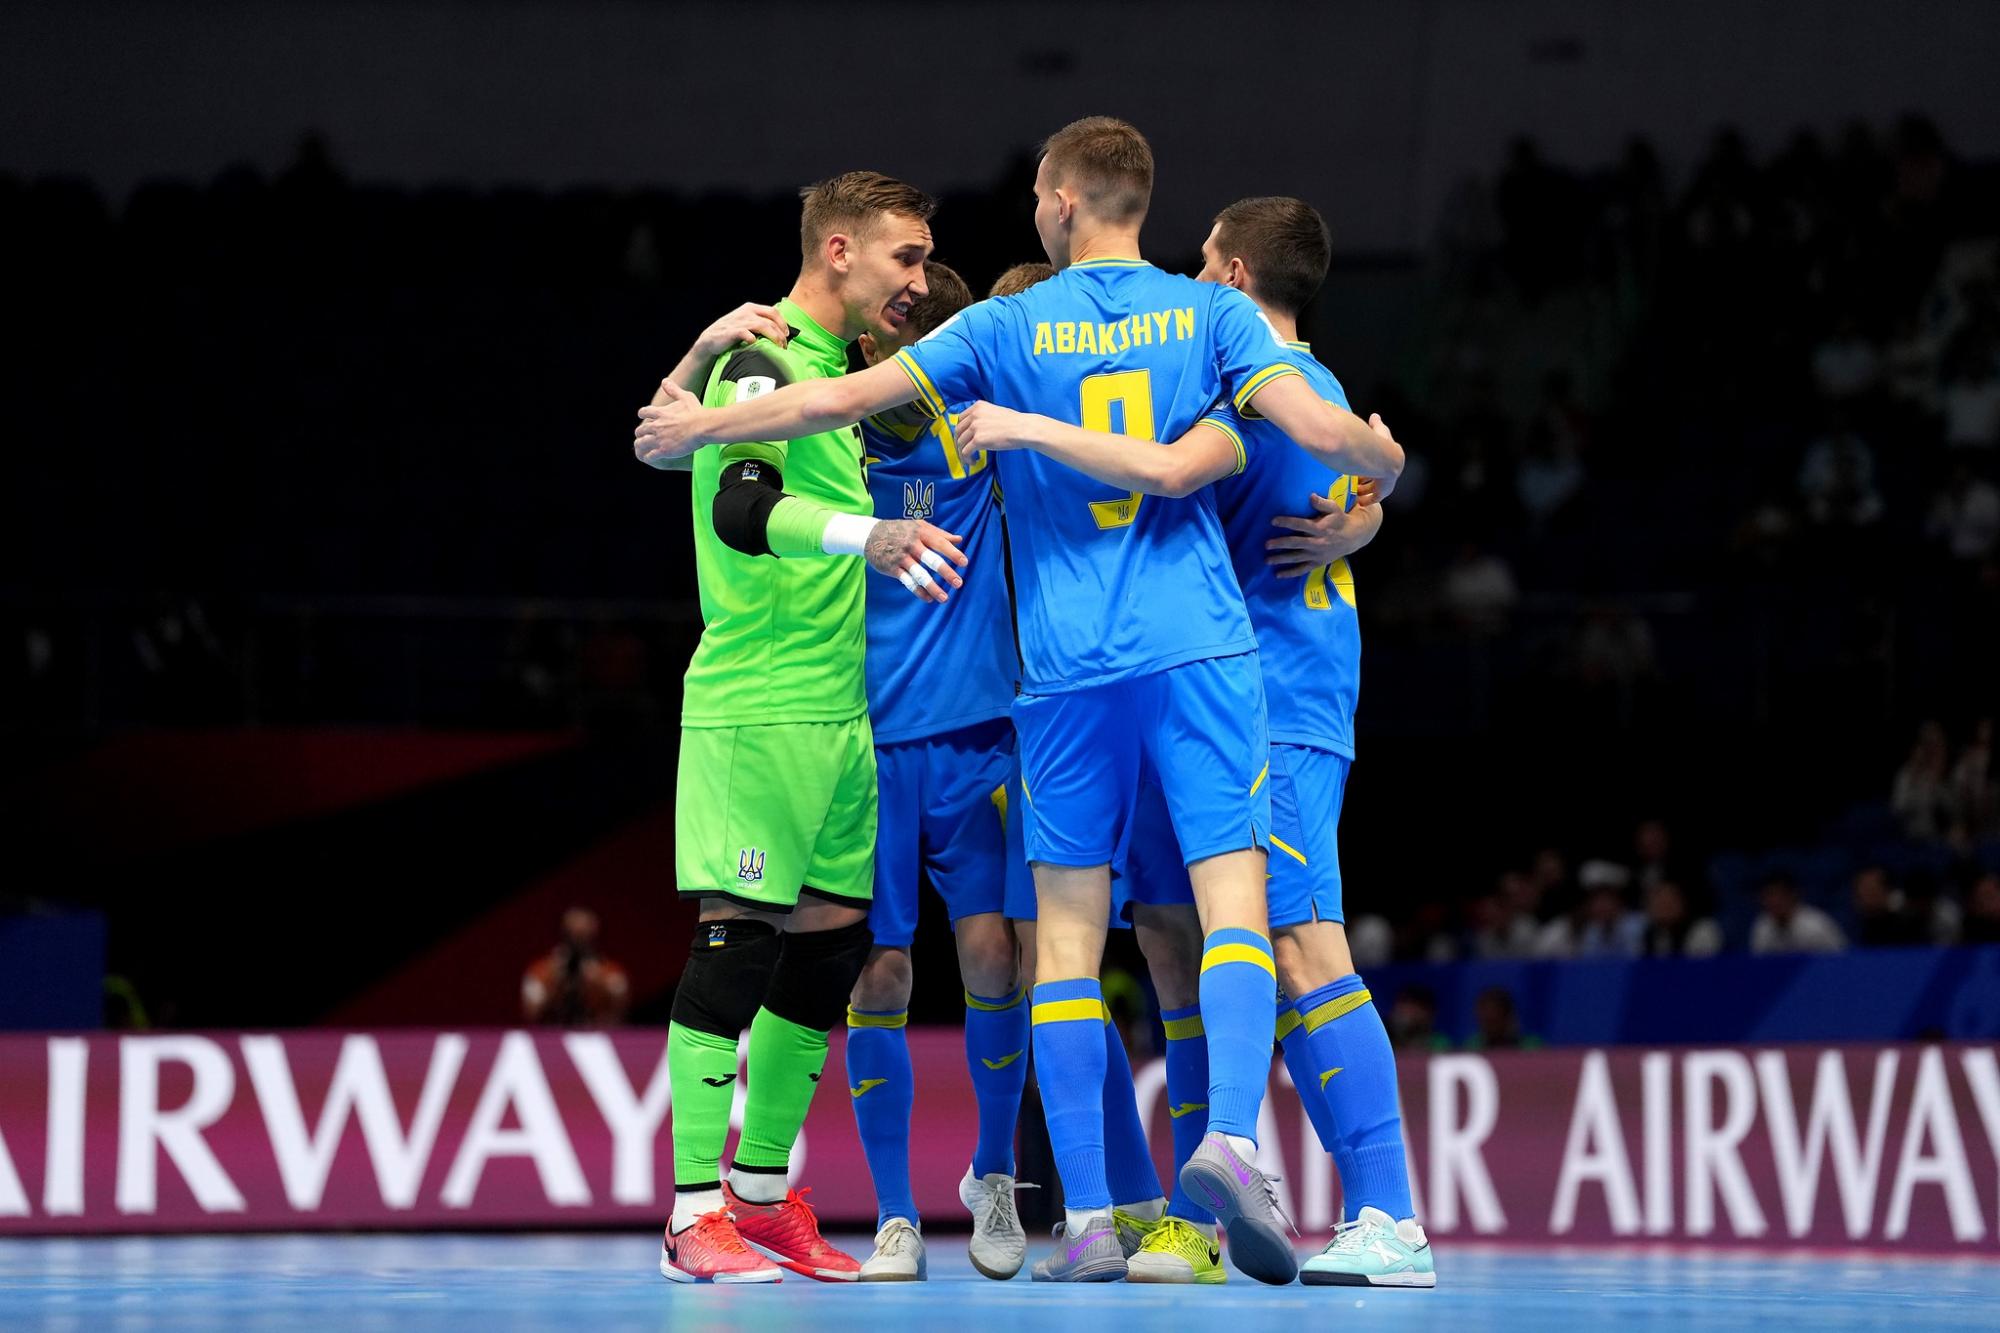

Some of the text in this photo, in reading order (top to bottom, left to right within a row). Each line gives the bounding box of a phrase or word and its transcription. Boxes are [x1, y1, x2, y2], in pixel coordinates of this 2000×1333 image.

[1033, 307, 1194, 356] ABAKSHYN
[1080, 368, 1155, 529] 9
[0, 1032, 807, 1217] IRWAY
